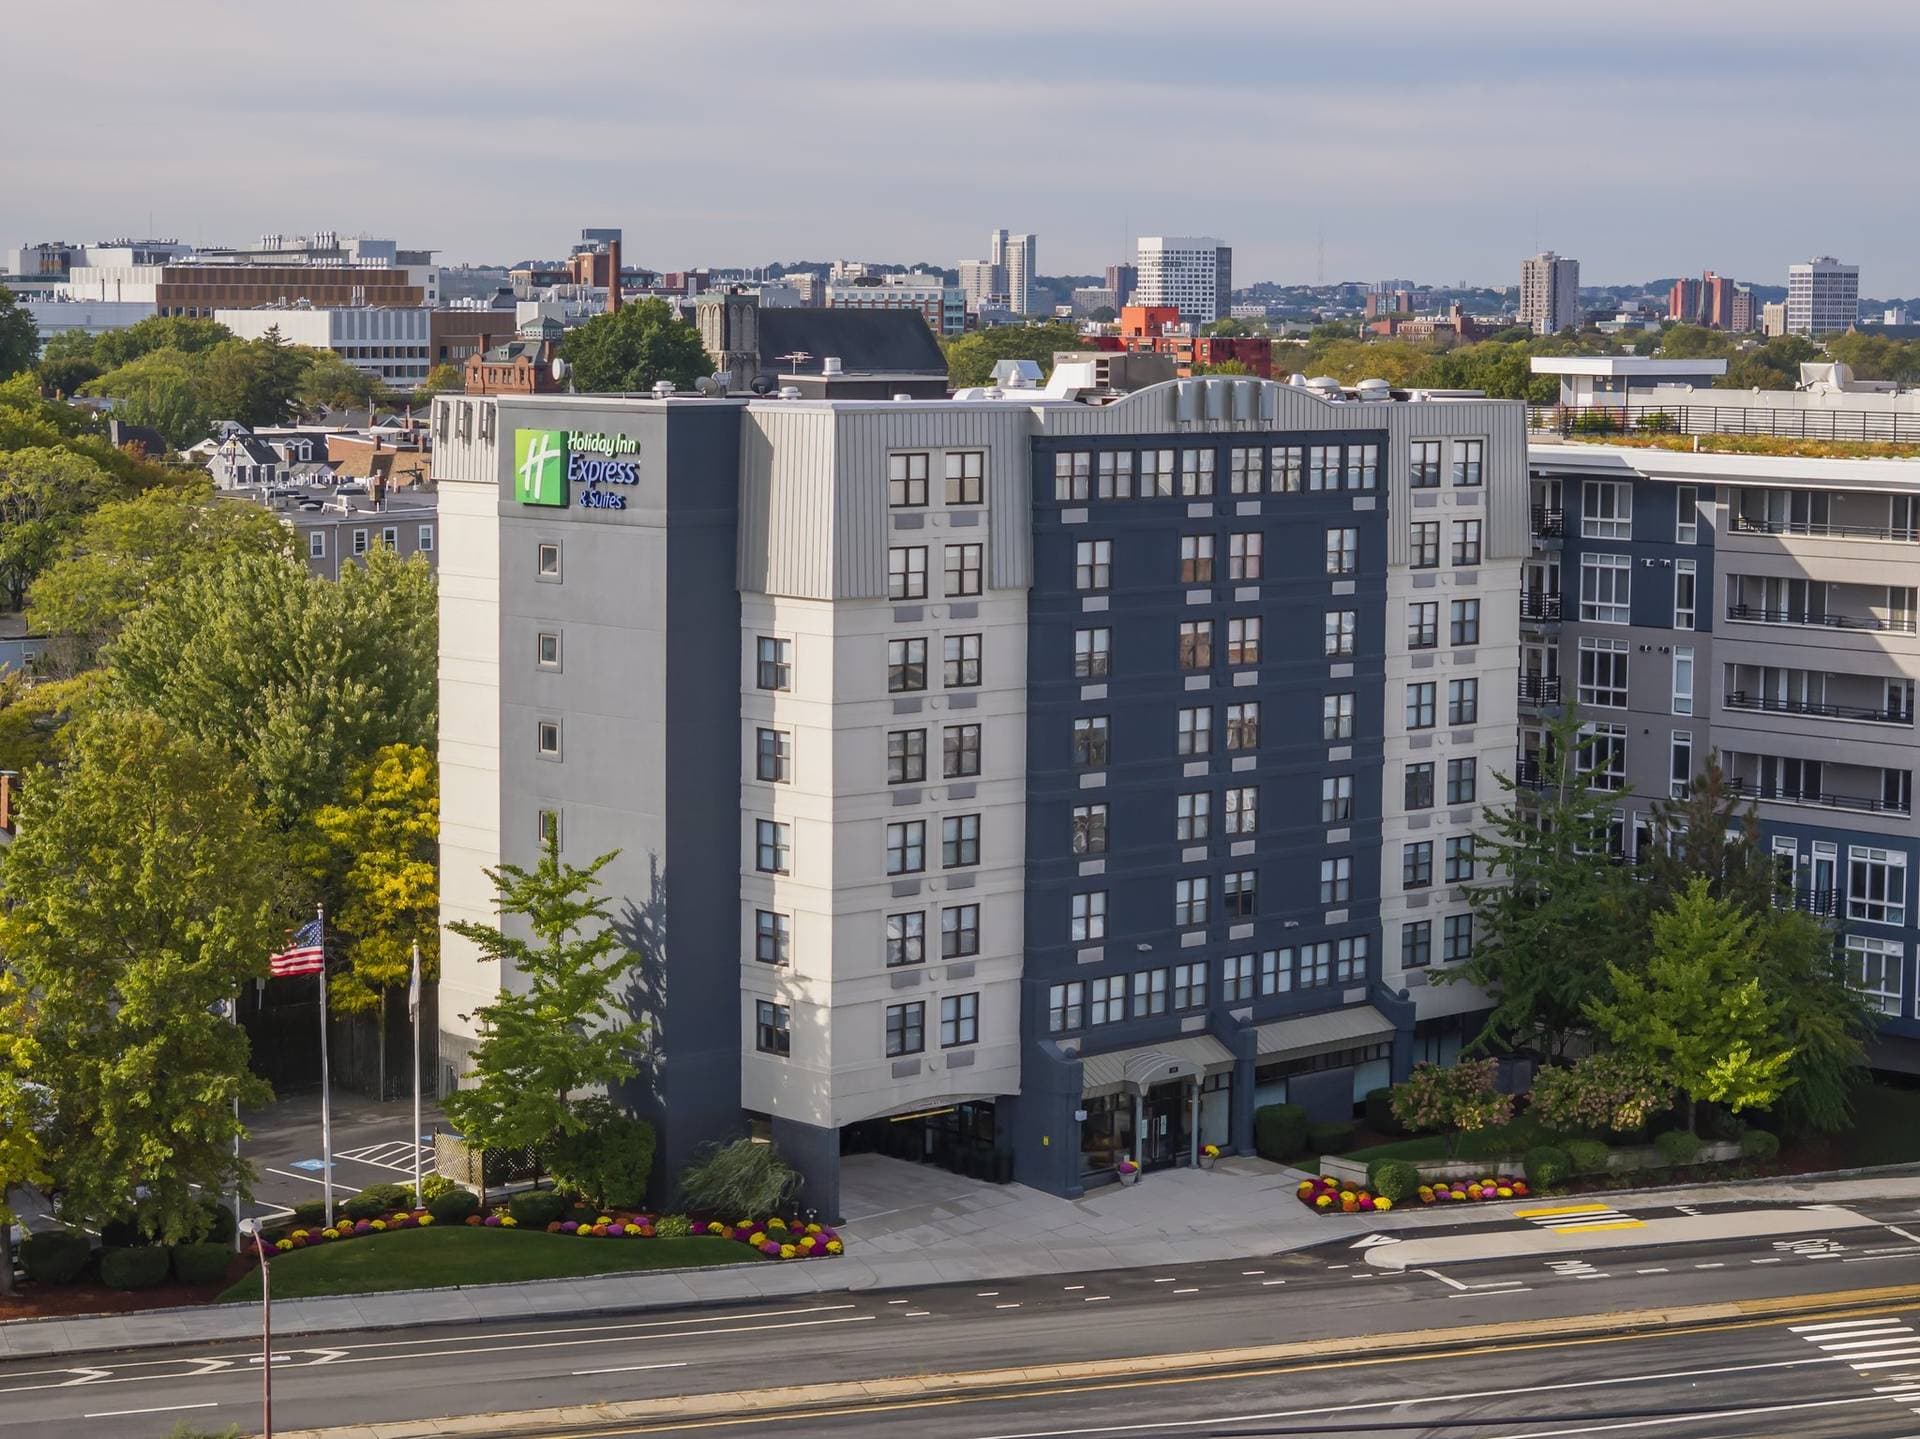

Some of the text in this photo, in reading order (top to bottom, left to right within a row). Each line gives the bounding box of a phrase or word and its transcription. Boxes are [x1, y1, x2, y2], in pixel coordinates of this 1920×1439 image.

[567, 430, 637, 457] Holiday Inn
[567, 454, 636, 486] Express
[579, 490, 623, 509] & Suites
